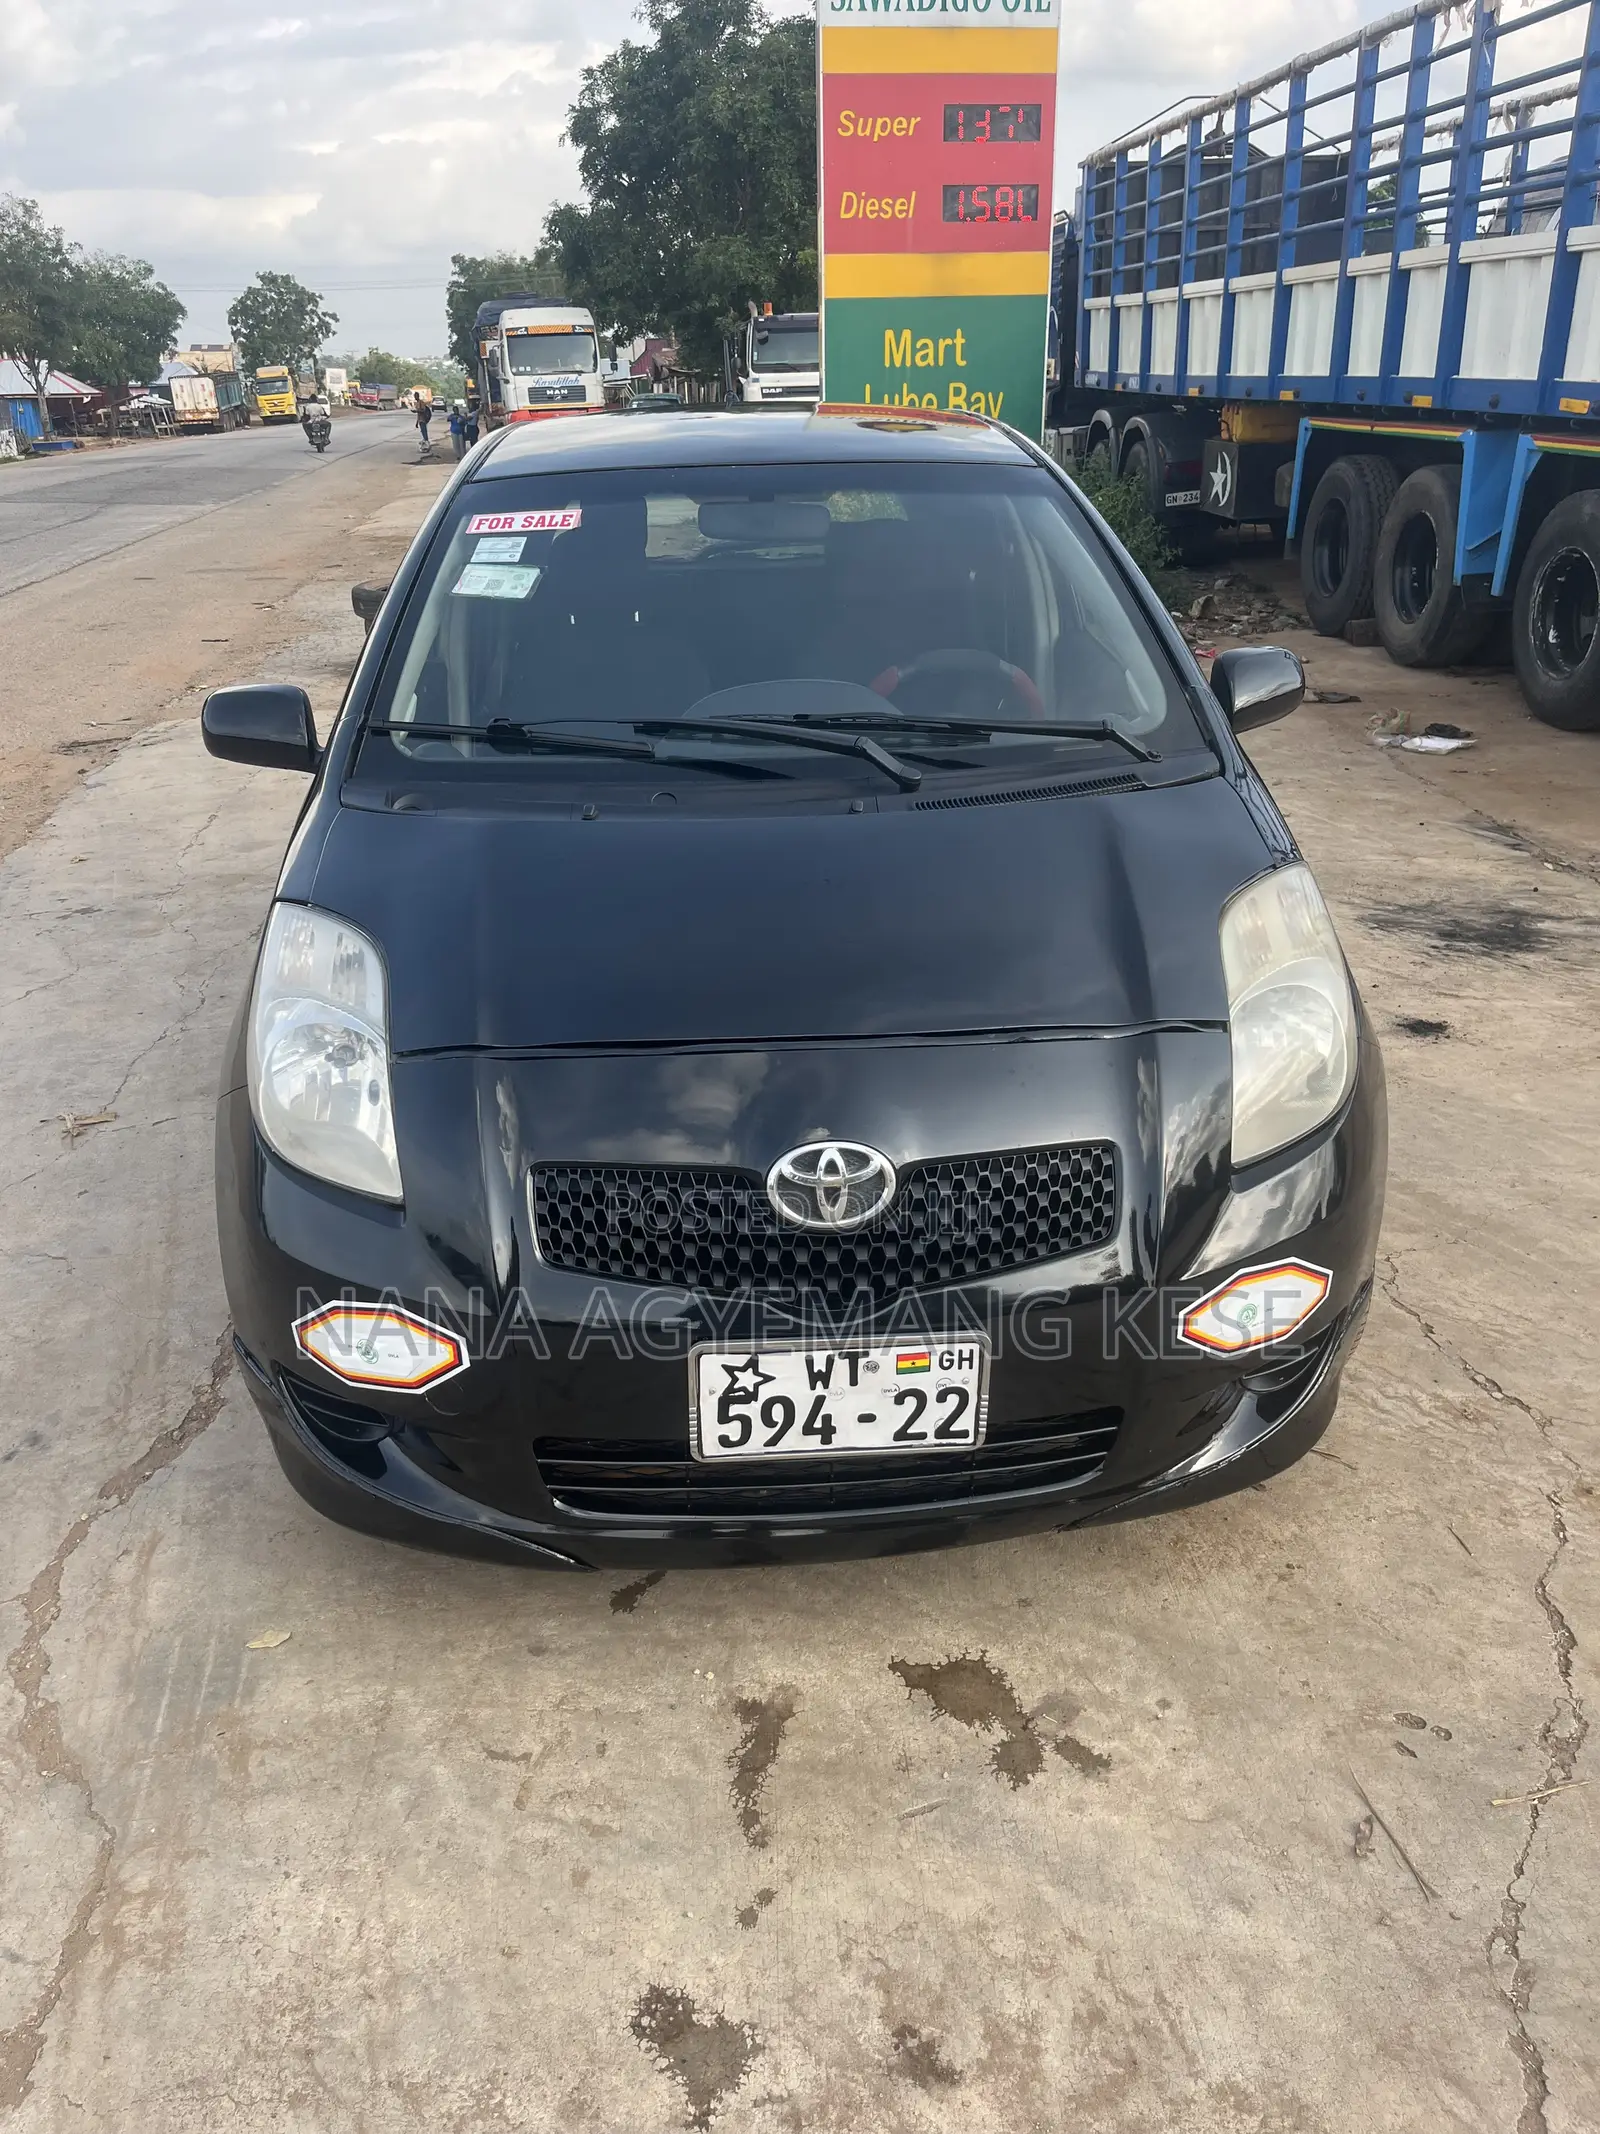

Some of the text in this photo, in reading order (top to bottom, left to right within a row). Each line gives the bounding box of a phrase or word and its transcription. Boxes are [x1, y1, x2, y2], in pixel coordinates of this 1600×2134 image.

[838, 109, 921, 142] Super
[840, 190, 916, 219] Diesel
[884, 328, 967, 368] Mart
[949, 381, 1004, 419] Bay
[474, 513, 574, 530] FOR SALE
[805, 1348, 975, 1391] WT GH
